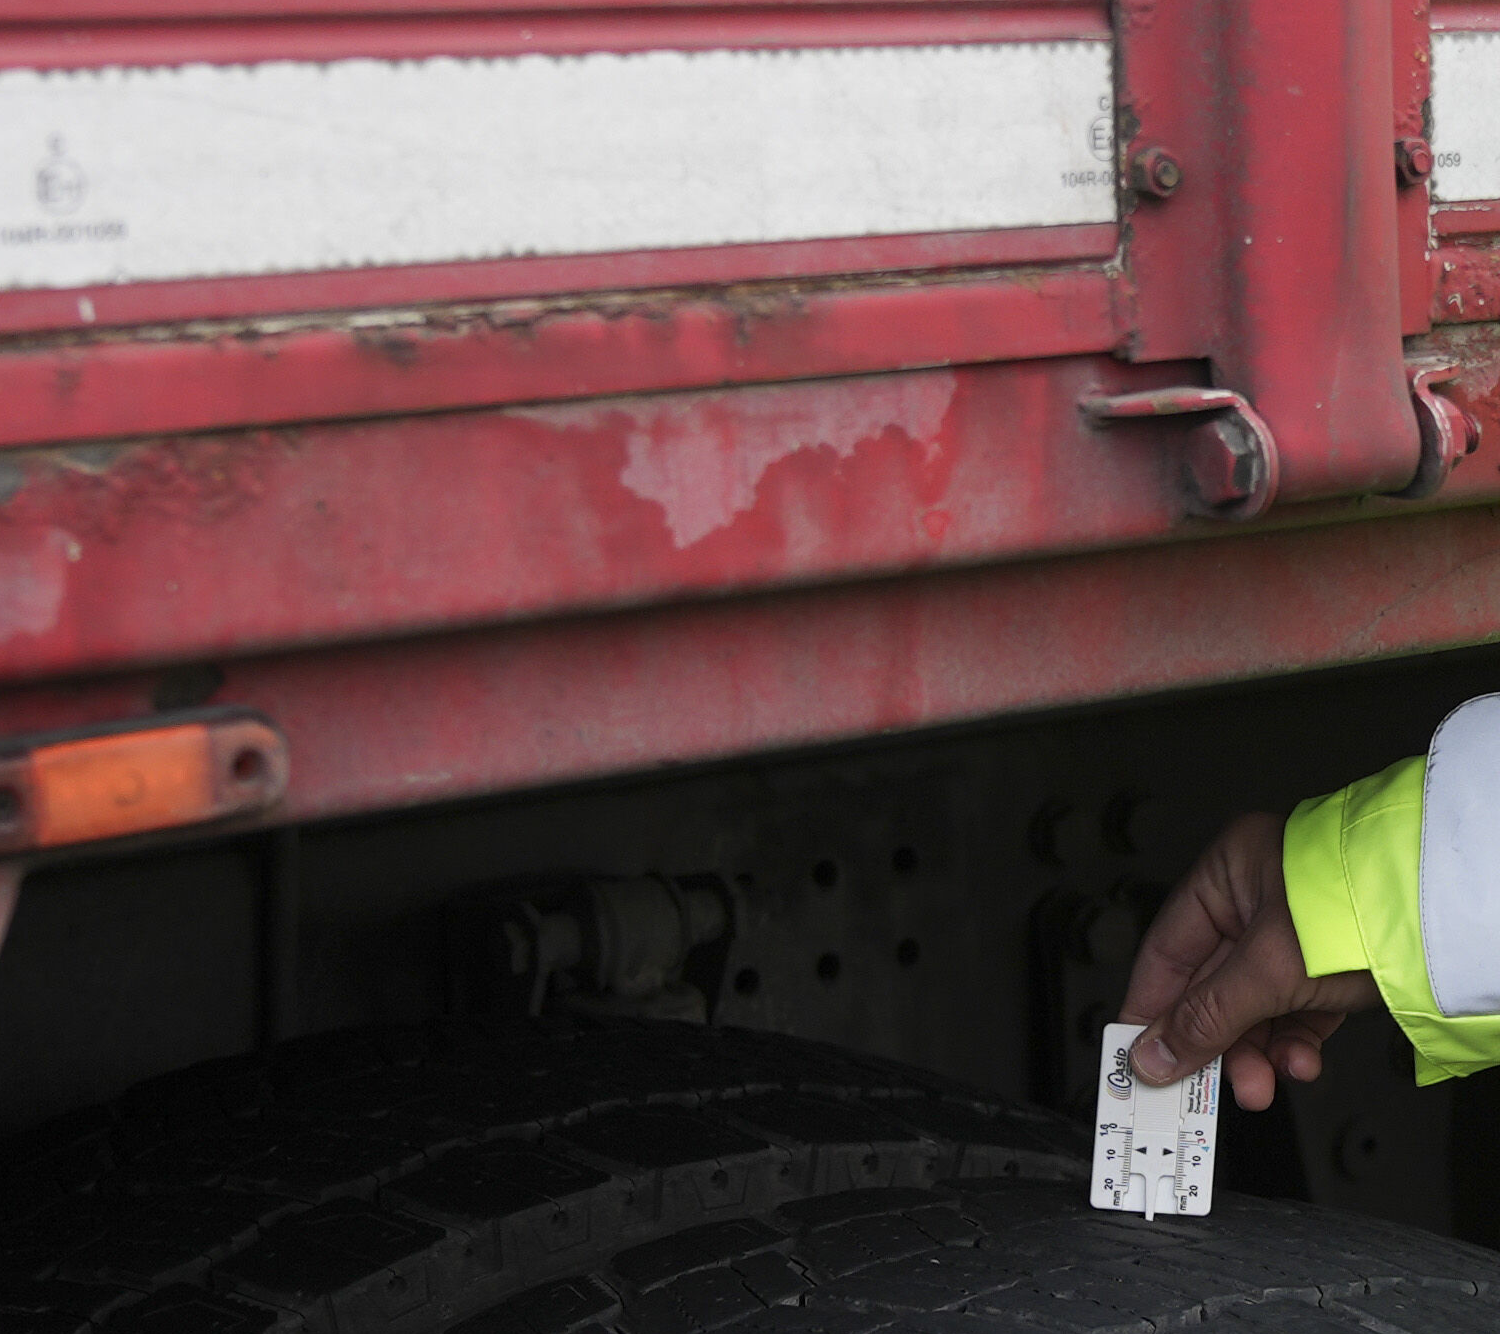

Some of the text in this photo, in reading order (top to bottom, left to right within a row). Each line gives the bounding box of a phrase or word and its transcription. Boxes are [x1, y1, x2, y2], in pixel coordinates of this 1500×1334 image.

[1106, 1149, 1116, 1161] 10
[1192, 1155, 1202, 1167] 10
[1104, 1178, 1114, 1191] 20
[1189, 1184, 1198, 1198] 20
